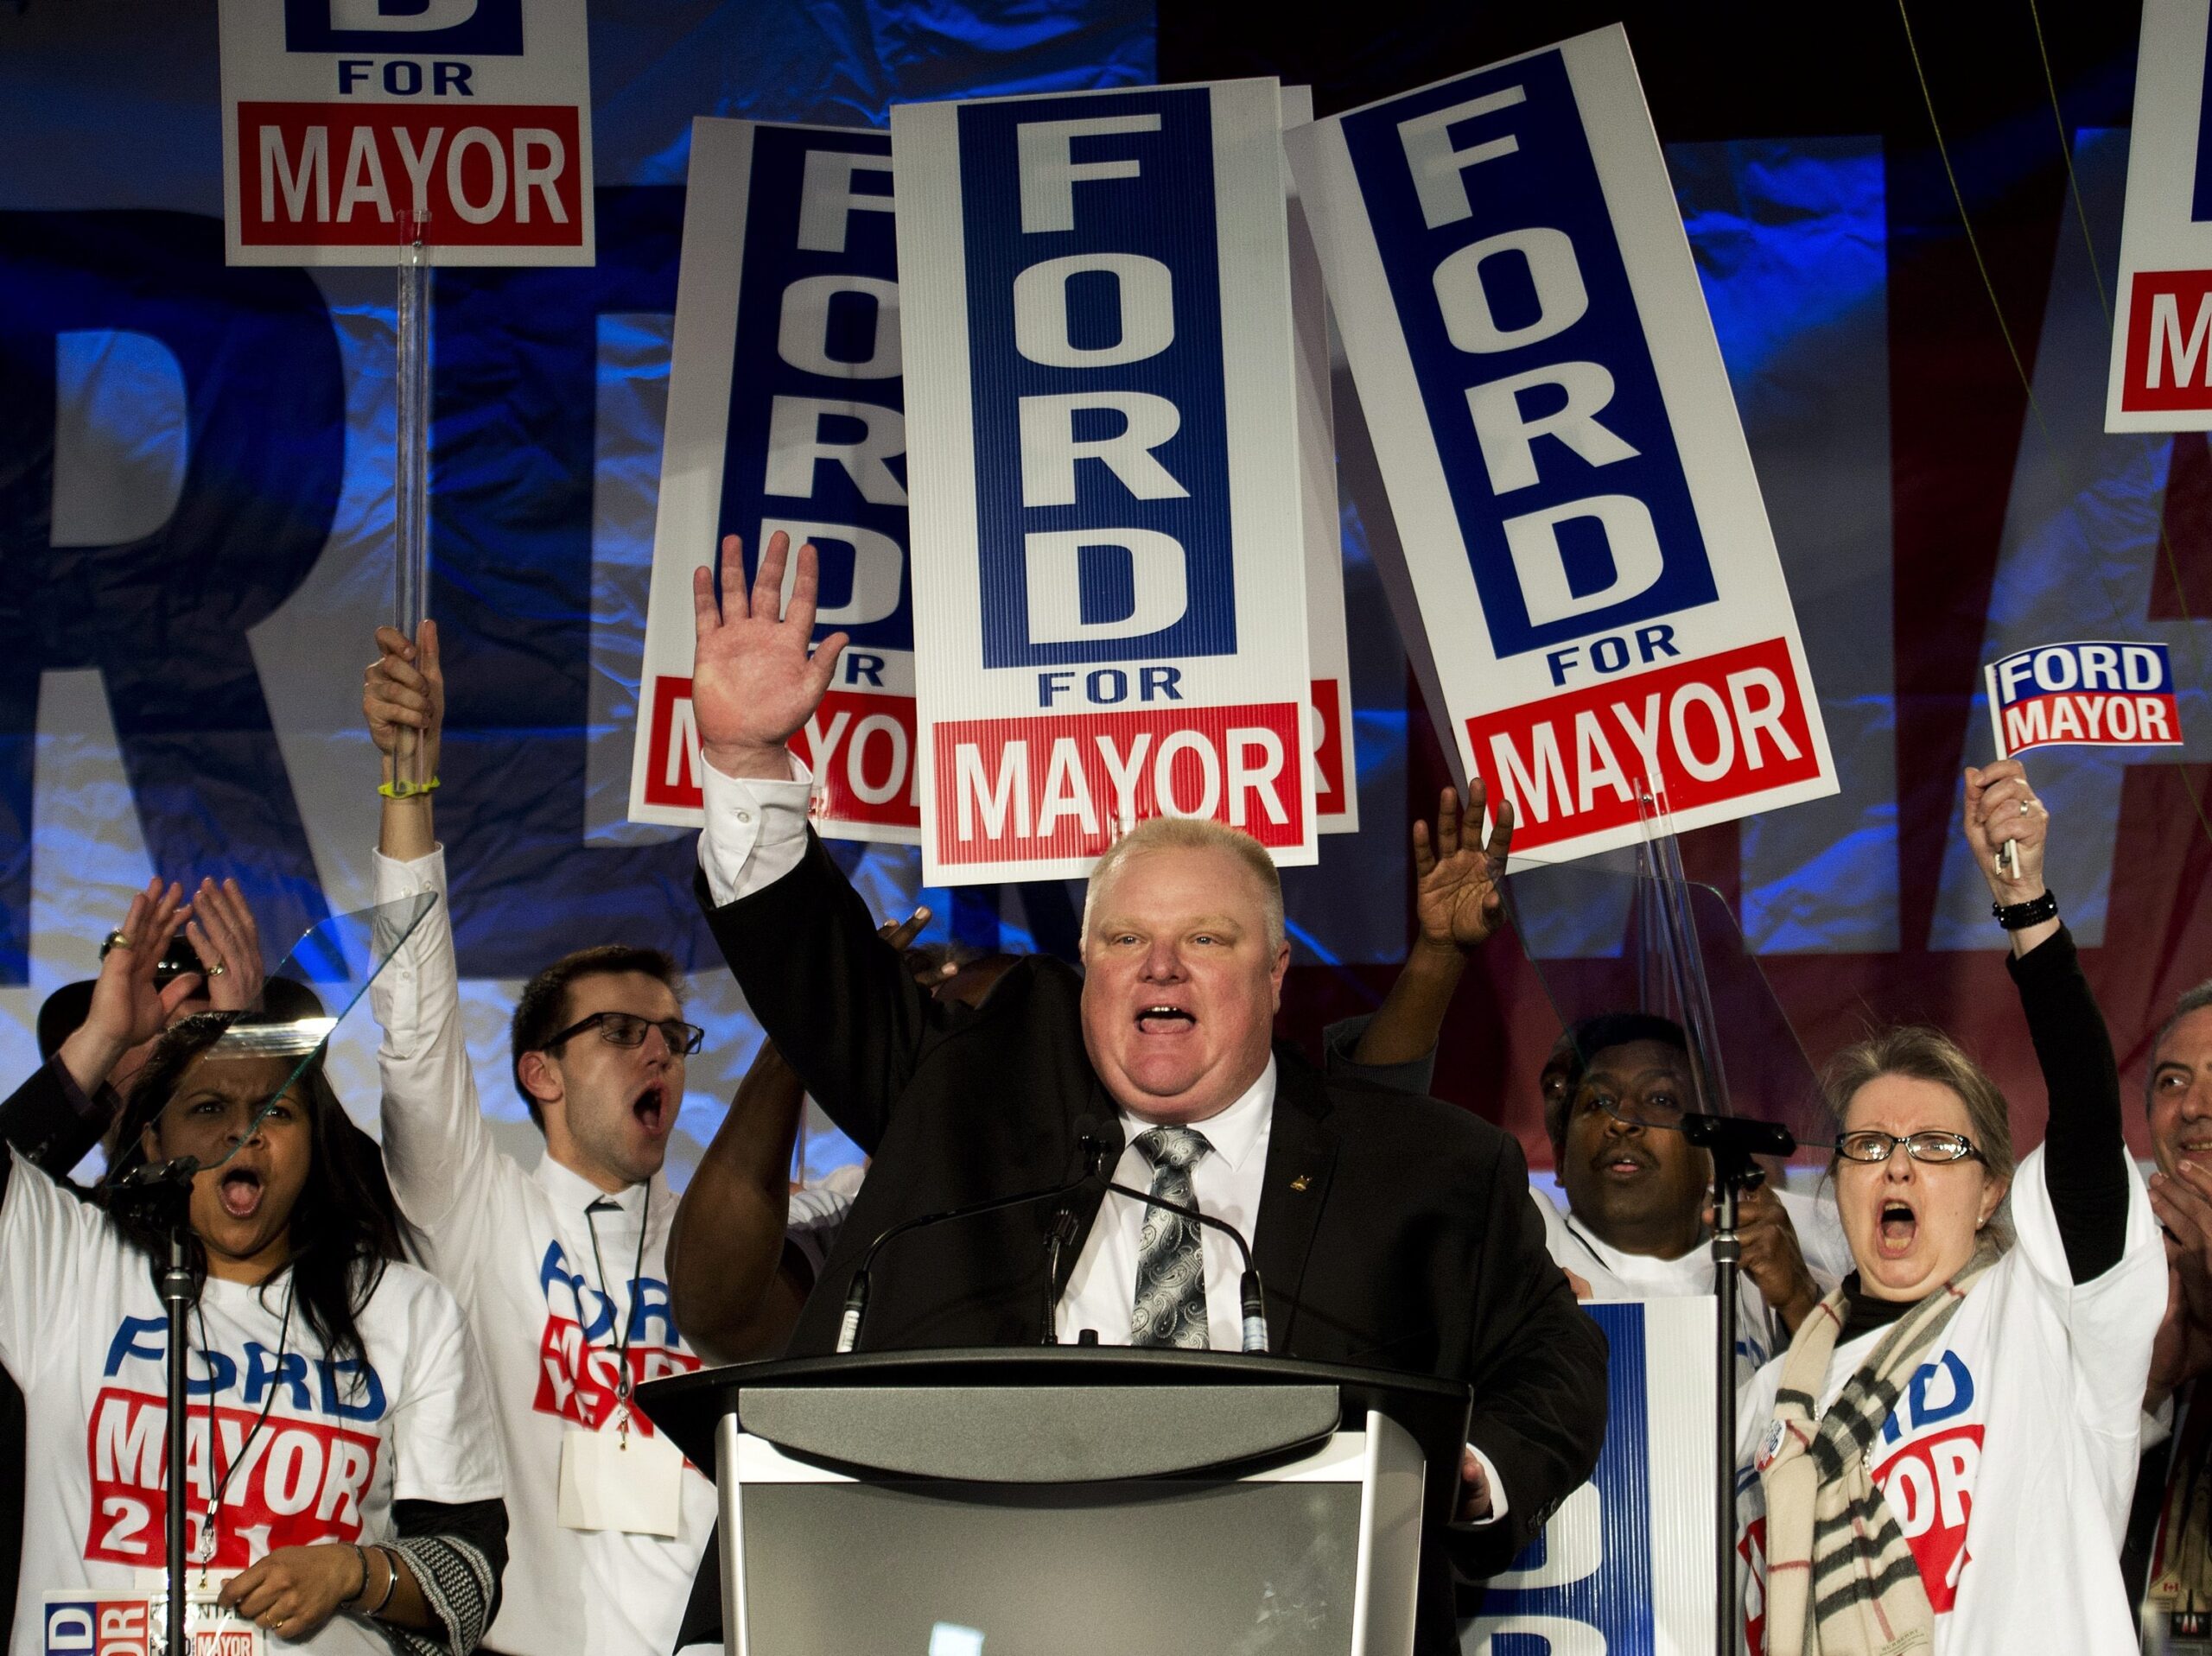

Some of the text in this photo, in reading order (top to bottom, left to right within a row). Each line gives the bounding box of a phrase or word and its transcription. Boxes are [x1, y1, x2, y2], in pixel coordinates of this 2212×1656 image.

[338, 60, 474, 97] FOR
[259, 124, 569, 225] MAYOR
[1013, 112, 1192, 645] FORD
[1395, 84, 1664, 629] FORD
[1038, 666, 1185, 709] FOR
[1547, 624, 1681, 686] FOR
[1998, 645, 2164, 705] FORD
[1489, 664, 1802, 832] MAYOR
[2005, 695, 2171, 751] MAYOR
[954, 726, 1291, 843] MAYOR
[103, 1315, 388, 1423] FORD
[94, 1398, 371, 1527] MAYOR
